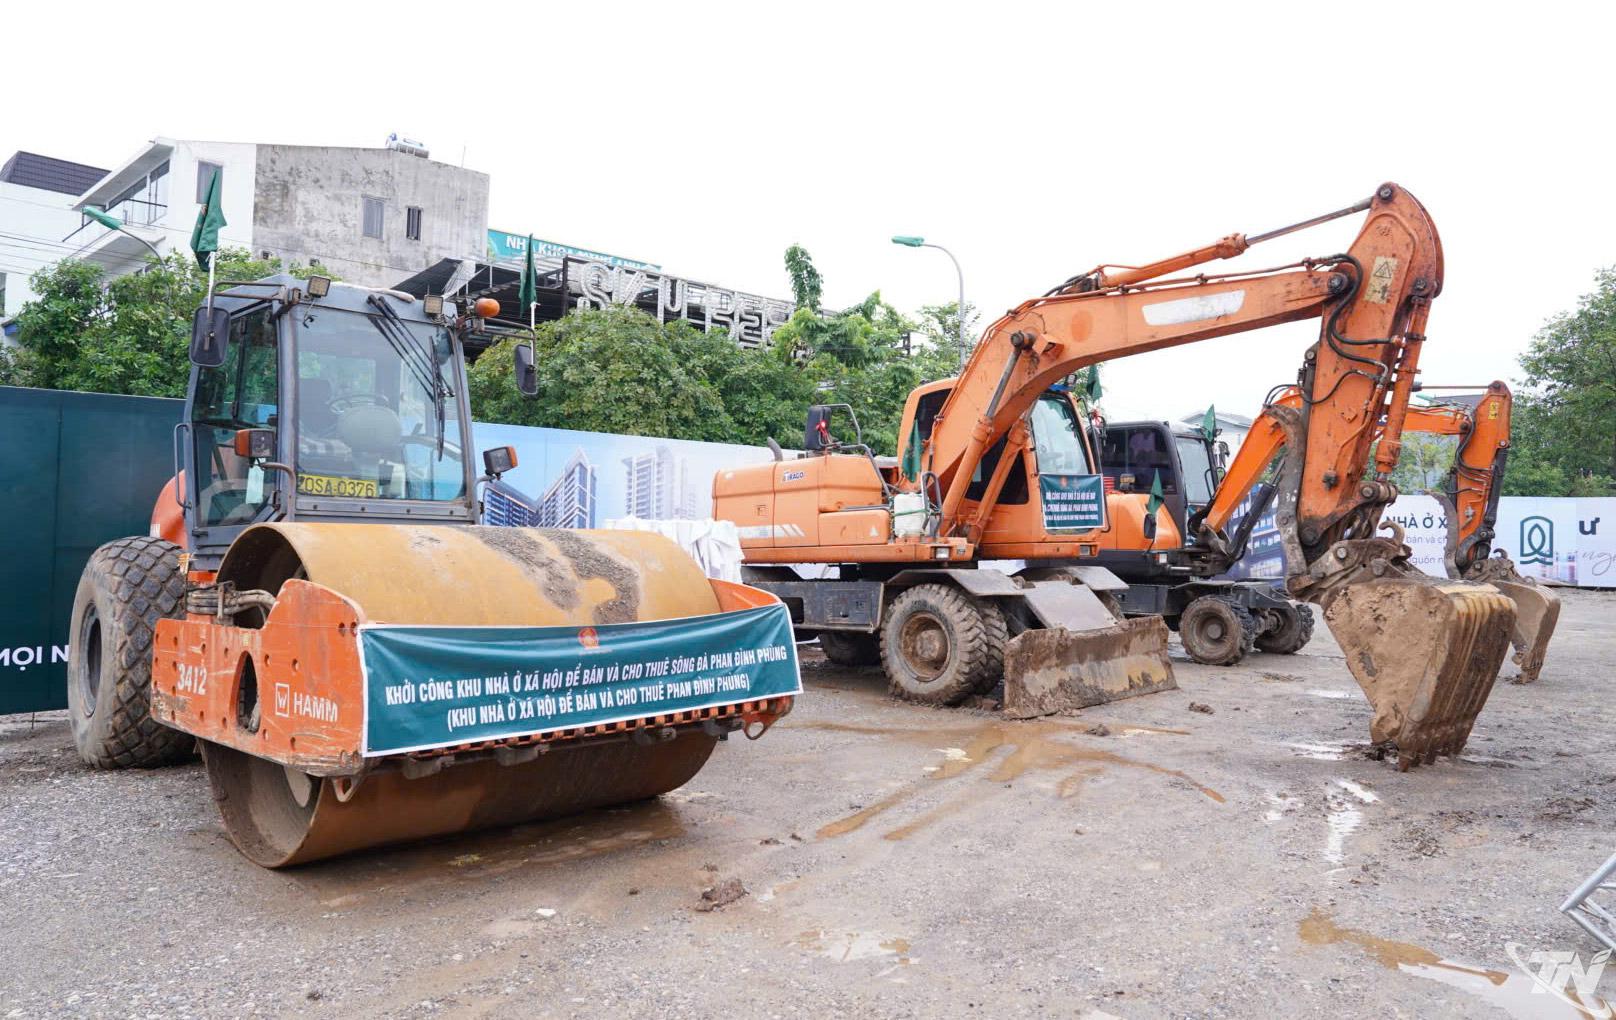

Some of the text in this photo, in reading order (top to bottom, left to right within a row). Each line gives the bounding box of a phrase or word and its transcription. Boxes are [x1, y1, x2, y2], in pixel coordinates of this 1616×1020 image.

[506, 235, 536, 253] NH
[1423, 512, 1434, 529] Ở
[177, 663, 207, 695] 3412
[386, 679, 416, 705] KHỞI
[419, 678, 453, 702] CÔNG
[457, 677, 481, 700] KHU
[486, 672, 510, 695] NHÀ
[513, 671, 522, 692] Ở
[524, 670, 539, 691] XÃ
[543, 668, 563, 694] HỘI
[566, 664, 580, 687] ĐỂ
[582, 664, 604, 686] BÁN
[606, 662, 621, 683] VÀ
[622, 664, 642, 681] CHO
[645, 657, 670, 678] THUÊ
[671, 656, 695, 674] SÔNG
[710, 653, 732, 669] PHAN
[734, 647, 756, 667] ĐÌNH
[757, 645, 787, 664] PHÙNG
[293, 692, 338, 722] HAMM
[448, 672, 750, 732] (KHU NHÀ Ở XÃ HỘI ĐỂ BÁN VÀ CHO THUÊ PHAN ĐÌNH PHÙNG)
